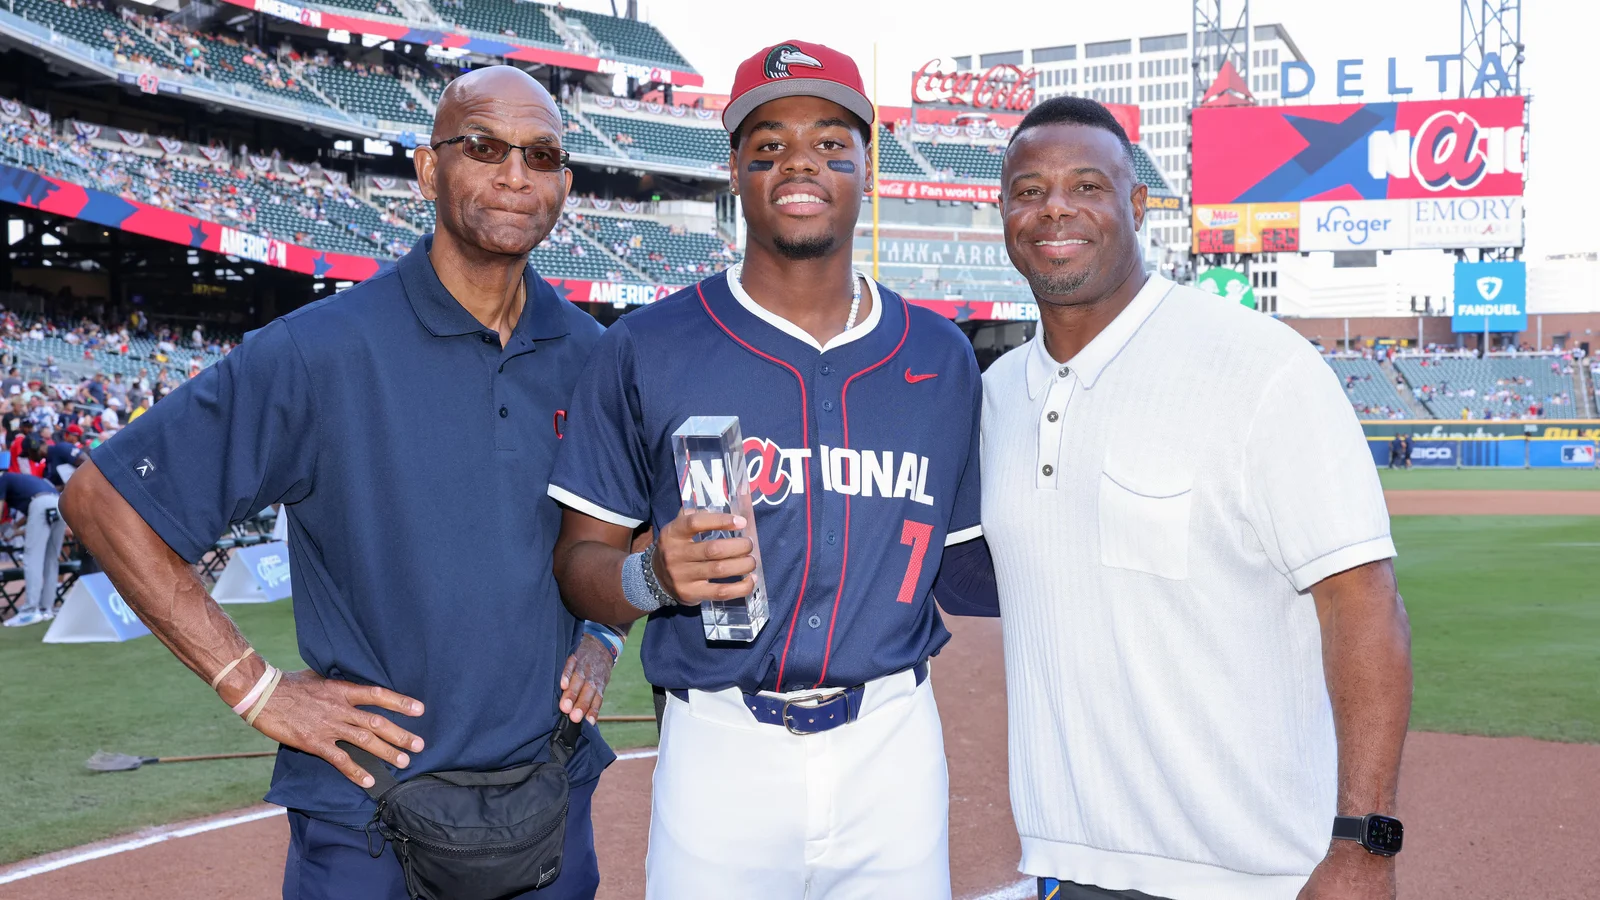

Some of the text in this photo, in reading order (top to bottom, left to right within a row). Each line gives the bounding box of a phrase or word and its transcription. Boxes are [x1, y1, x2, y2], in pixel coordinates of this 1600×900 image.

[911, 58, 1041, 112] Coca-Cola
[1281, 53, 1513, 98] DELTA
[920, 184, 943, 197] Fan
[944, 188, 976, 200] work
[977, 189, 988, 200] is
[1316, 206, 1392, 245] Kroger
[1415, 199, 1516, 222] EMORY
[219, 226, 287, 268] AMERICAN
[588, 281, 684, 305] AMERICA
[1458, 303, 1521, 316] FANDUEL
[1410, 447, 1452, 459] EICO
[896, 519, 935, 604] 7
